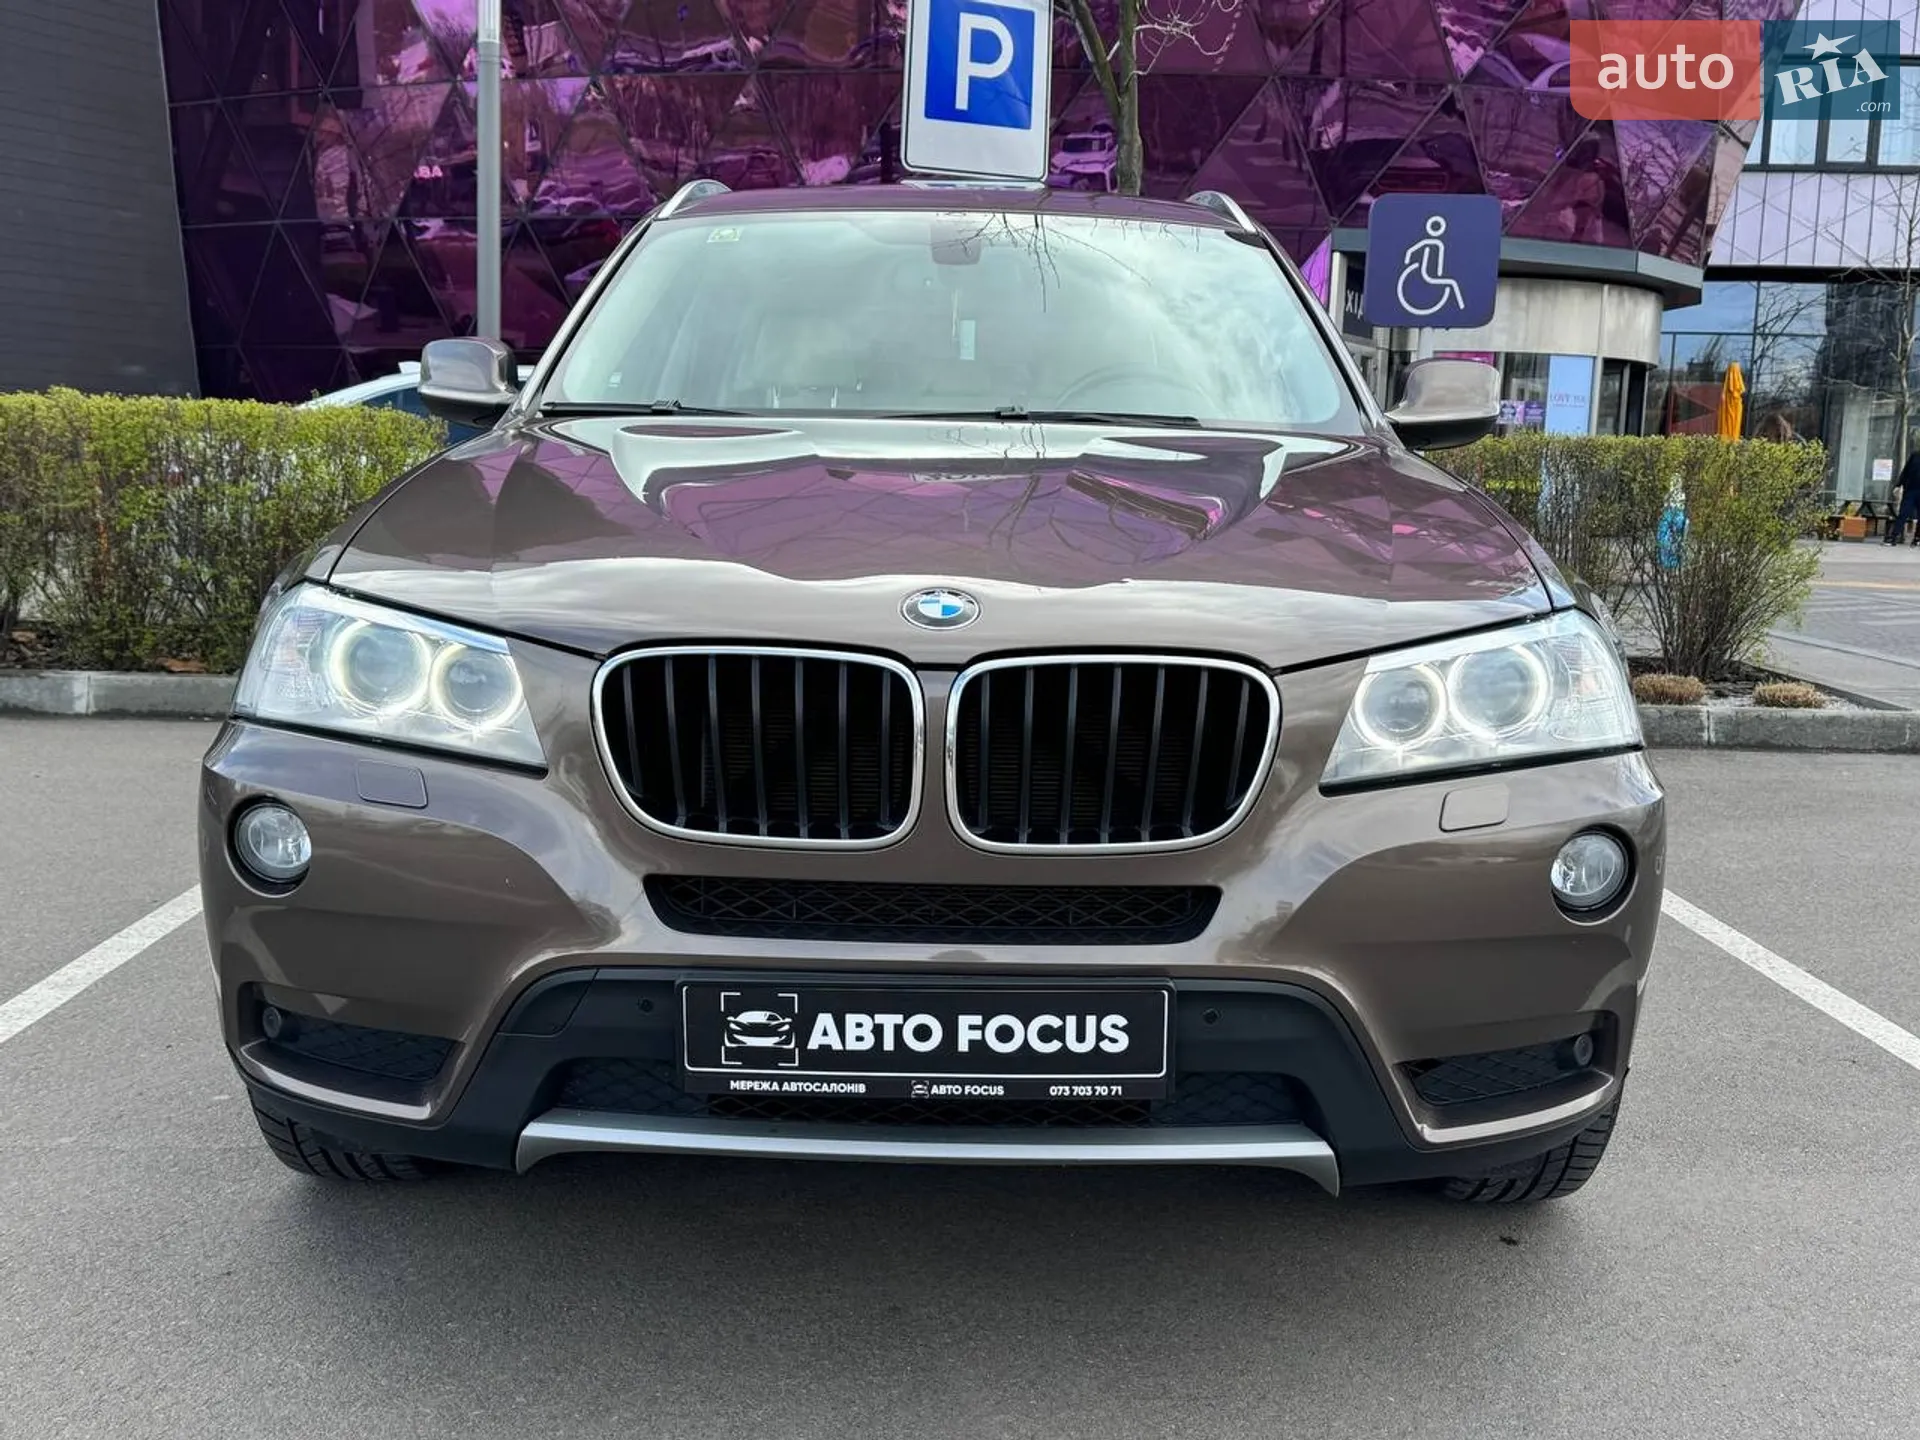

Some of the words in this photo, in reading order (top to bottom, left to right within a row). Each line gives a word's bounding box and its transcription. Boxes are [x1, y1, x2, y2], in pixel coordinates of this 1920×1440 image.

[955, 12, 1014, 111] P
[807, 1013, 943, 1052] АВТО
[957, 1014, 1130, 1053] FOCUS
[730, 1080, 779, 1092] МЕРЕЖА
[782, 1081, 866, 1094] АВТОСАЛОНІВ
[931, 1084, 962, 1096] АВТО
[964, 1085, 1005, 1096] FOCUS
[1049, 1086, 1071, 1096] 073
[1072, 1086, 1093, 1096] 703
[1094, 1086, 1108, 1096] 70
[1110, 1086, 1123, 1096] 71
